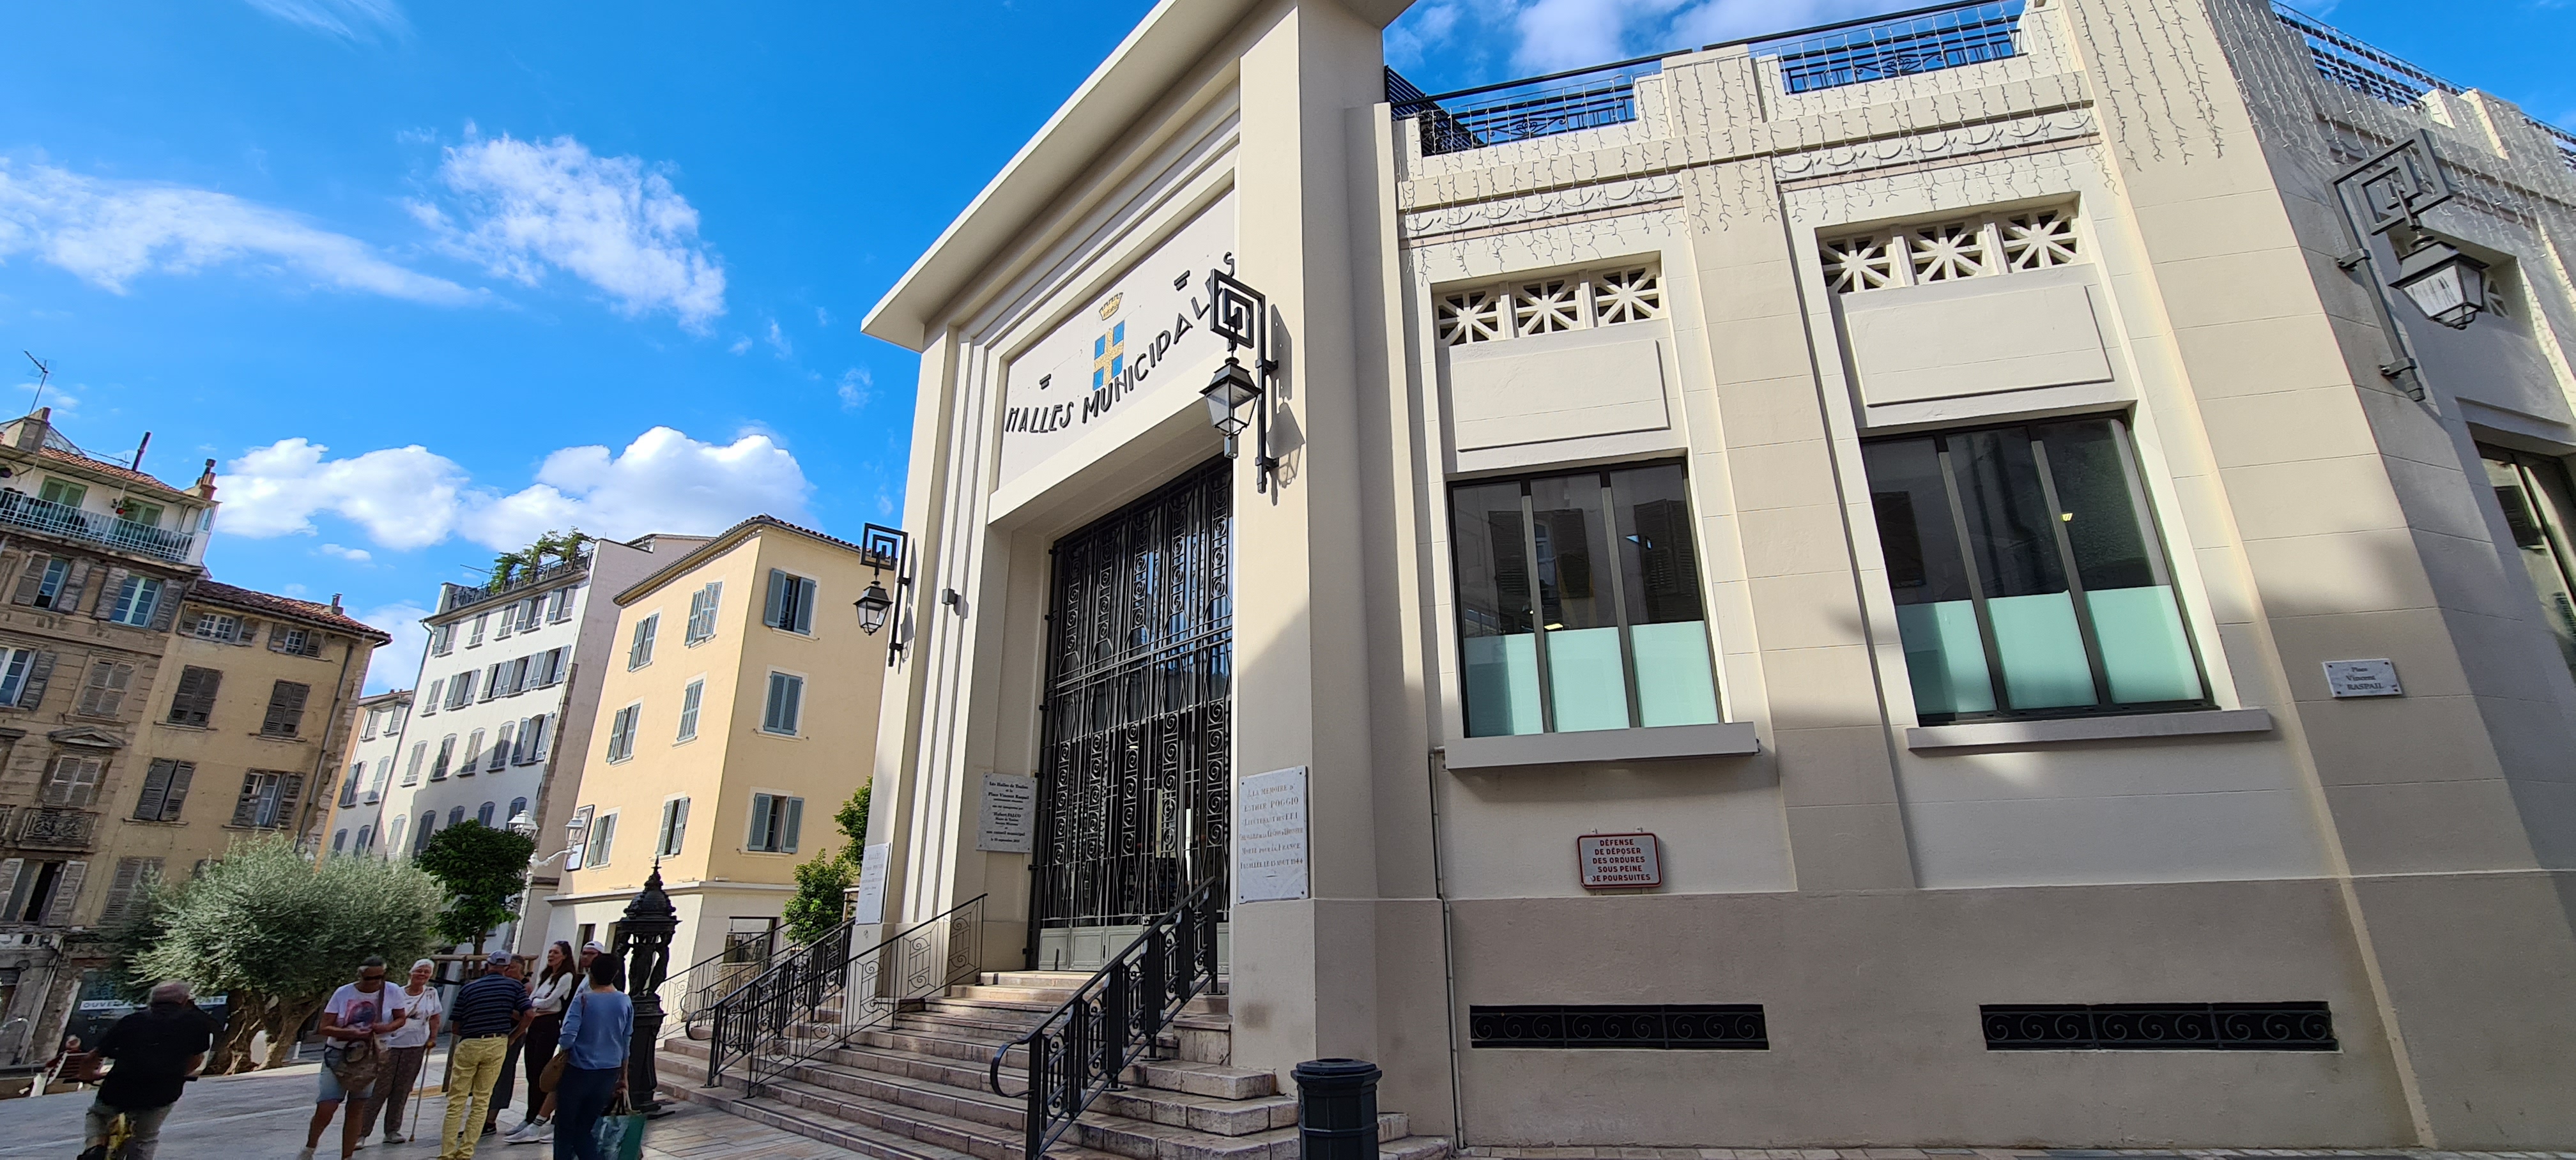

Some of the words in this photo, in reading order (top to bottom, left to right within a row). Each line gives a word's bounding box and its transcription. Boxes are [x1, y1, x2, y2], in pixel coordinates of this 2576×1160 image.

[1005, 401, 1074, 433] HALLES
[1082, 251, 1235, 424] MUNICIPALS
[1244, 802, 1267, 812] ESTHER
[1271, 797, 1299, 808] POGGIO
